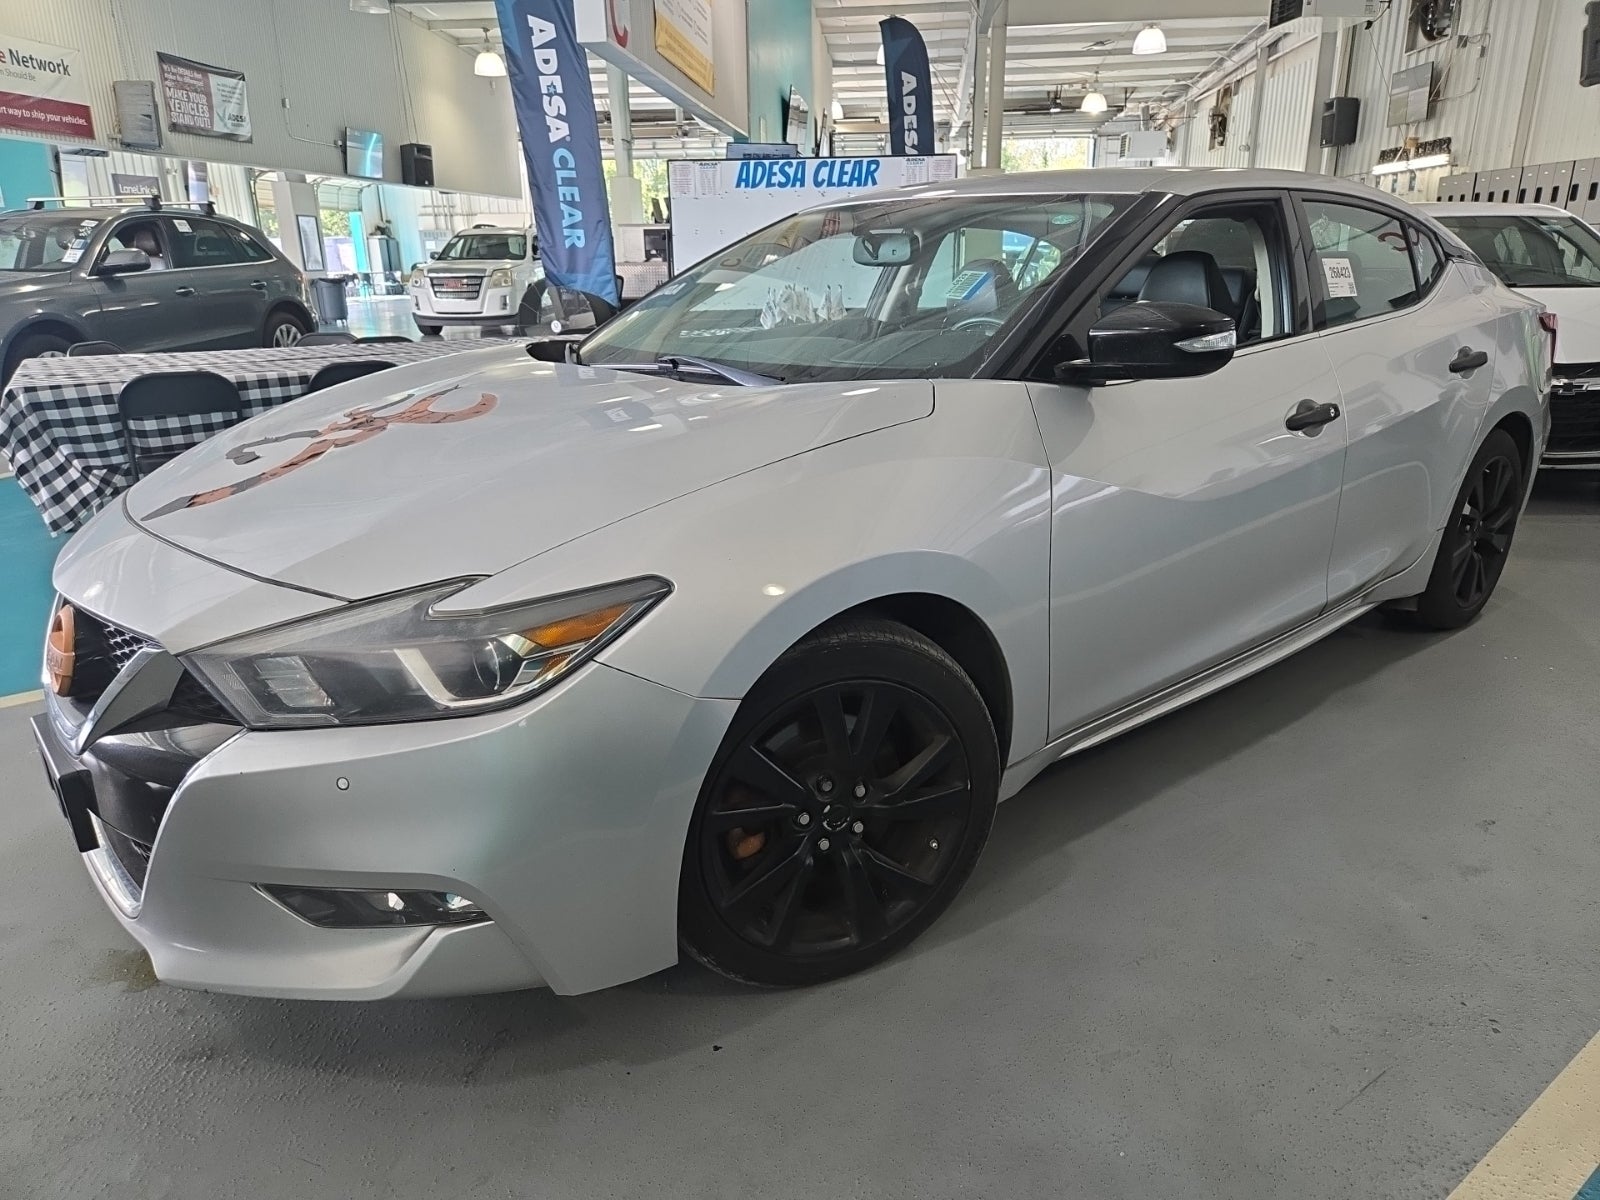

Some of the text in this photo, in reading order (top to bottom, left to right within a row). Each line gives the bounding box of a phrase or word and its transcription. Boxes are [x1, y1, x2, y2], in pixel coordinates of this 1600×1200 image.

[8, 48, 71, 77] Network
[6, 68, 28, 80] Should
[166, 87, 189, 101] MAKE
[189, 91, 208, 105] YOUR
[7, 108, 22, 118] way
[22, 109, 31, 118] to
[31, 110, 46, 120] ship
[46, 112, 61, 122] your
[61, 115, 88, 126] vehicles.
[168, 98, 210, 118] VEHICLES
[171, 112, 211, 129] STAND OUT!
[527, 14, 586, 249] ADESA CLEAR
[735, 160, 806, 189] ADESA
[812, 158, 880, 189] CLEAR
